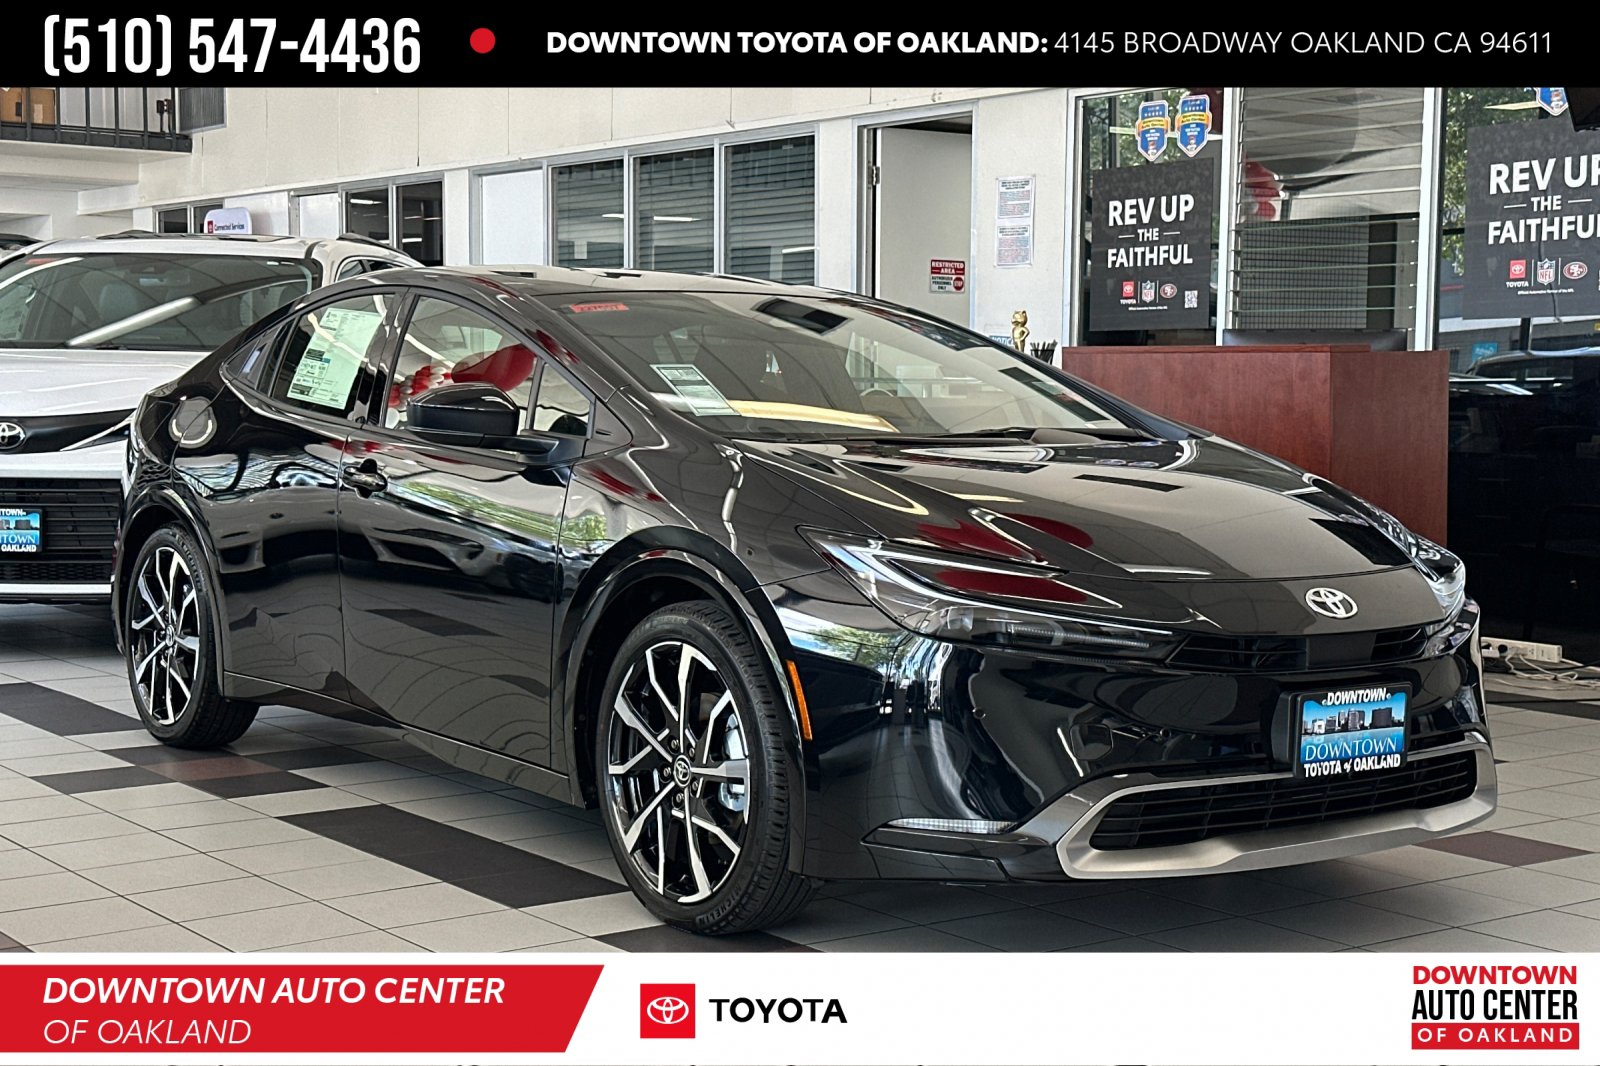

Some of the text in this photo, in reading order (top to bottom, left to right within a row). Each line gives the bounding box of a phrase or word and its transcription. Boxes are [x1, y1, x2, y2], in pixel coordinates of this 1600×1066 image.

[1488, 158, 1557, 195] REV
[1108, 193, 1195, 226] REV UP
[1530, 195, 1562, 212] THE
[1137, 228, 1160, 242] THE
[931, 261, 965, 269] RESTRICTED
[1107, 243, 1193, 269] FAITHFUL
[1, 544, 37, 552] OAKLAND
[1327, 687, 1387, 706] DOWNTOWN
[1305, 737, 1397, 761] DOWNTOWN
[1303, 753, 1401, 778] TOYOTA of OAKLAND
